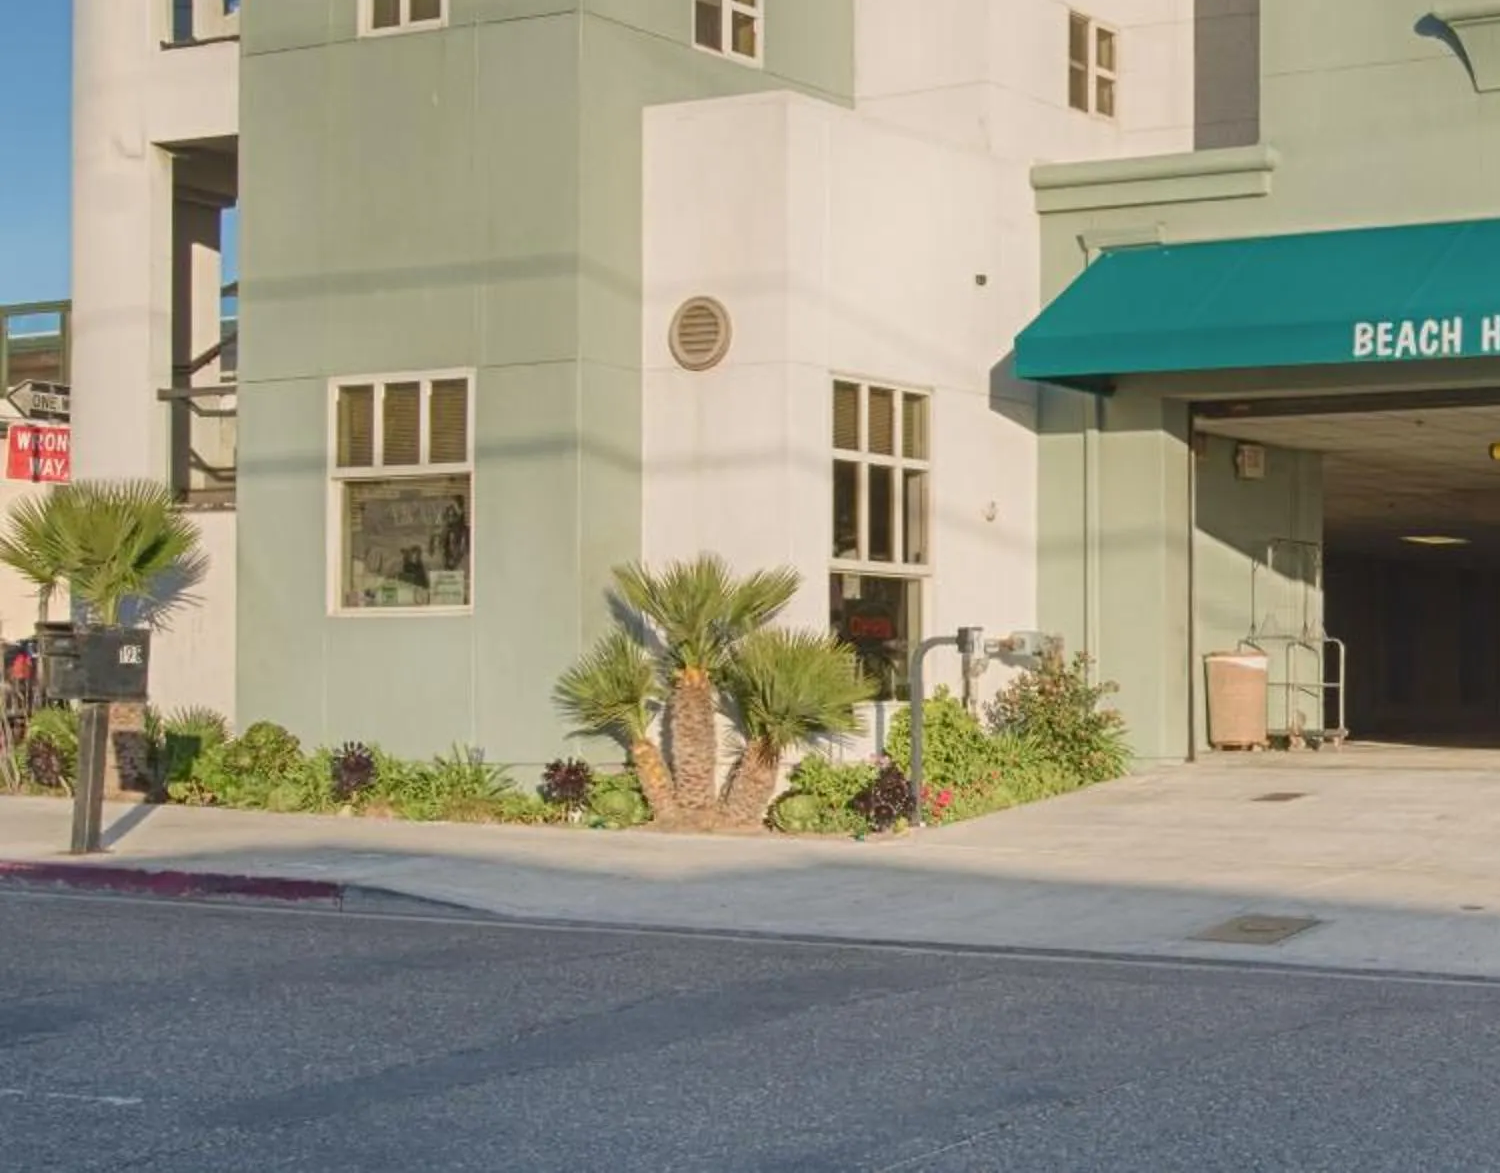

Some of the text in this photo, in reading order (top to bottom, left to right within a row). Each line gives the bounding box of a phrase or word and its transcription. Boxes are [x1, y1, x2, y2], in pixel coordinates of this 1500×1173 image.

[1352, 317, 1463, 359] BEACH
[32, 394, 57, 410] ONE
[29, 458, 66, 476] WAY
